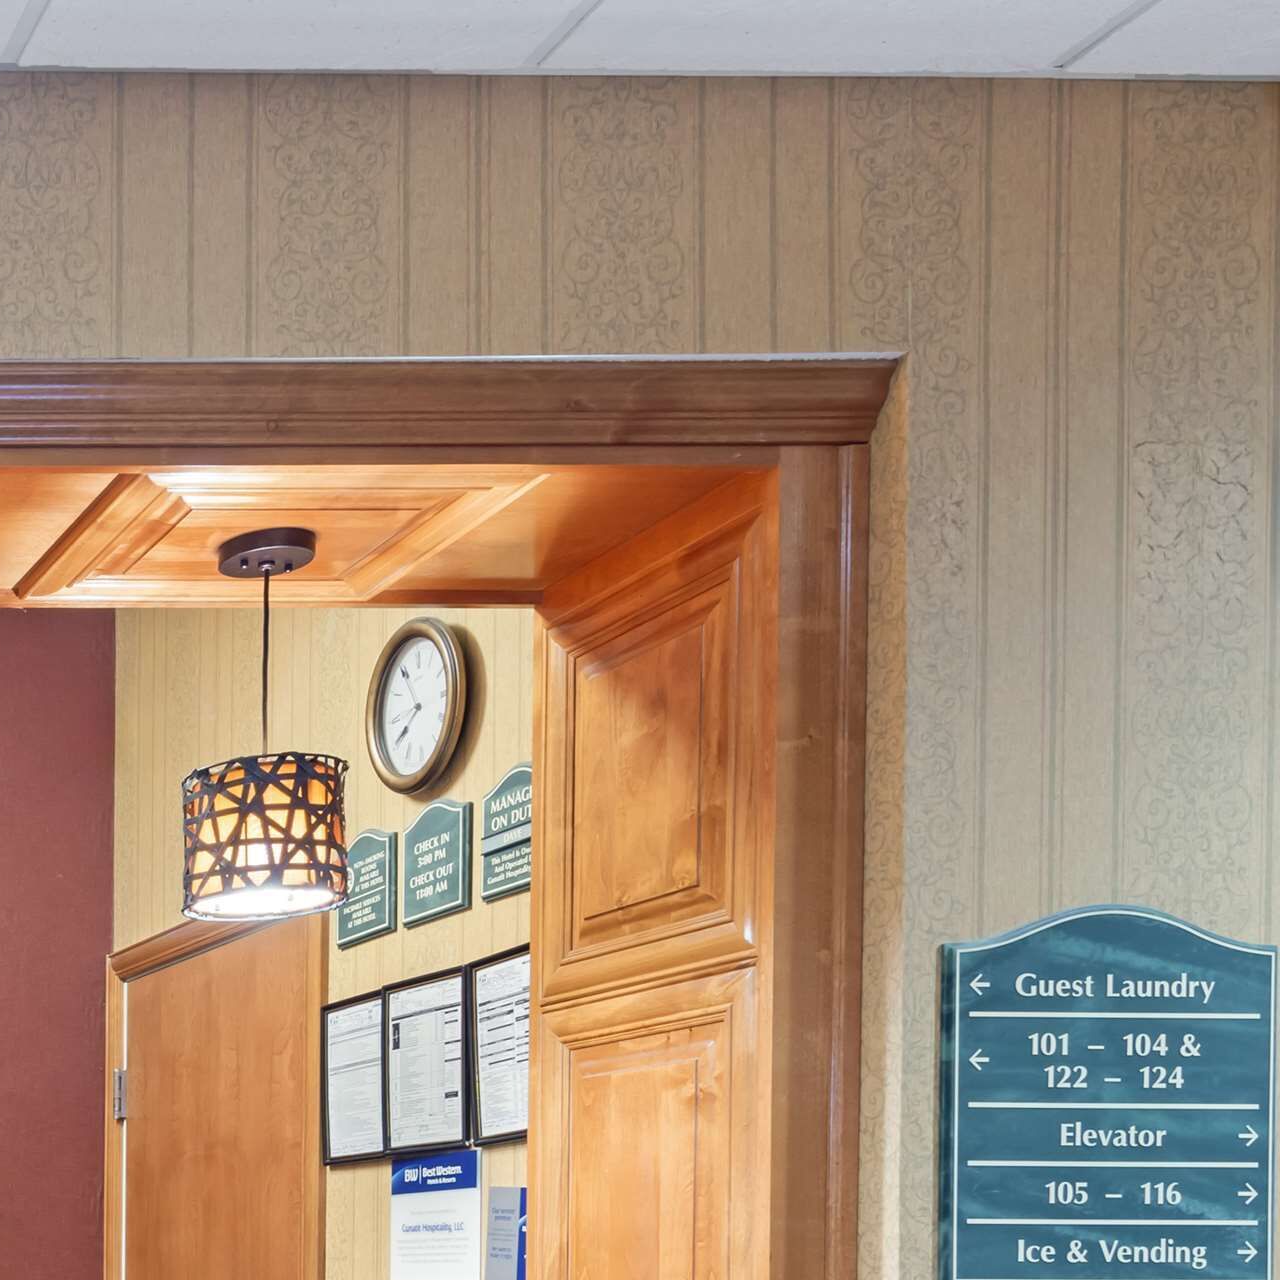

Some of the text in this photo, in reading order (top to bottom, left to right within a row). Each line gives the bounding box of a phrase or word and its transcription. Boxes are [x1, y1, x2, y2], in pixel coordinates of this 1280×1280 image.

[490, 785, 532, 814] MANAG
[491, 804, 532, 831] ON DUT
[414, 831, 450, 855] CHECK IN
[417, 847, 446, 868] 3:00 PM
[409, 862, 454, 889] CHECK OUT
[416, 879, 448, 900] 11:00 AM
[1015, 973, 1216, 1004] Guest Laundry
[1028, 1033, 1070, 1056] 101
[1123, 1033, 1169, 1057] 104
[1180, 1034, 1201, 1057] &
[1044, 1065, 1088, 1089] 122
[1139, 1066, 1184, 1089] 124
[1059, 1121, 1167, 1148] Elevator
[404, 1168, 418, 1183] BW
[422, 1167, 436, 1178] Best
[1045, 1181, 1089, 1205] 105
[1140, 1182, 1182, 1205] 116
[454, 1221, 465, 1231] LLC
[1017, 1239, 1208, 1269] Ice & Vending
